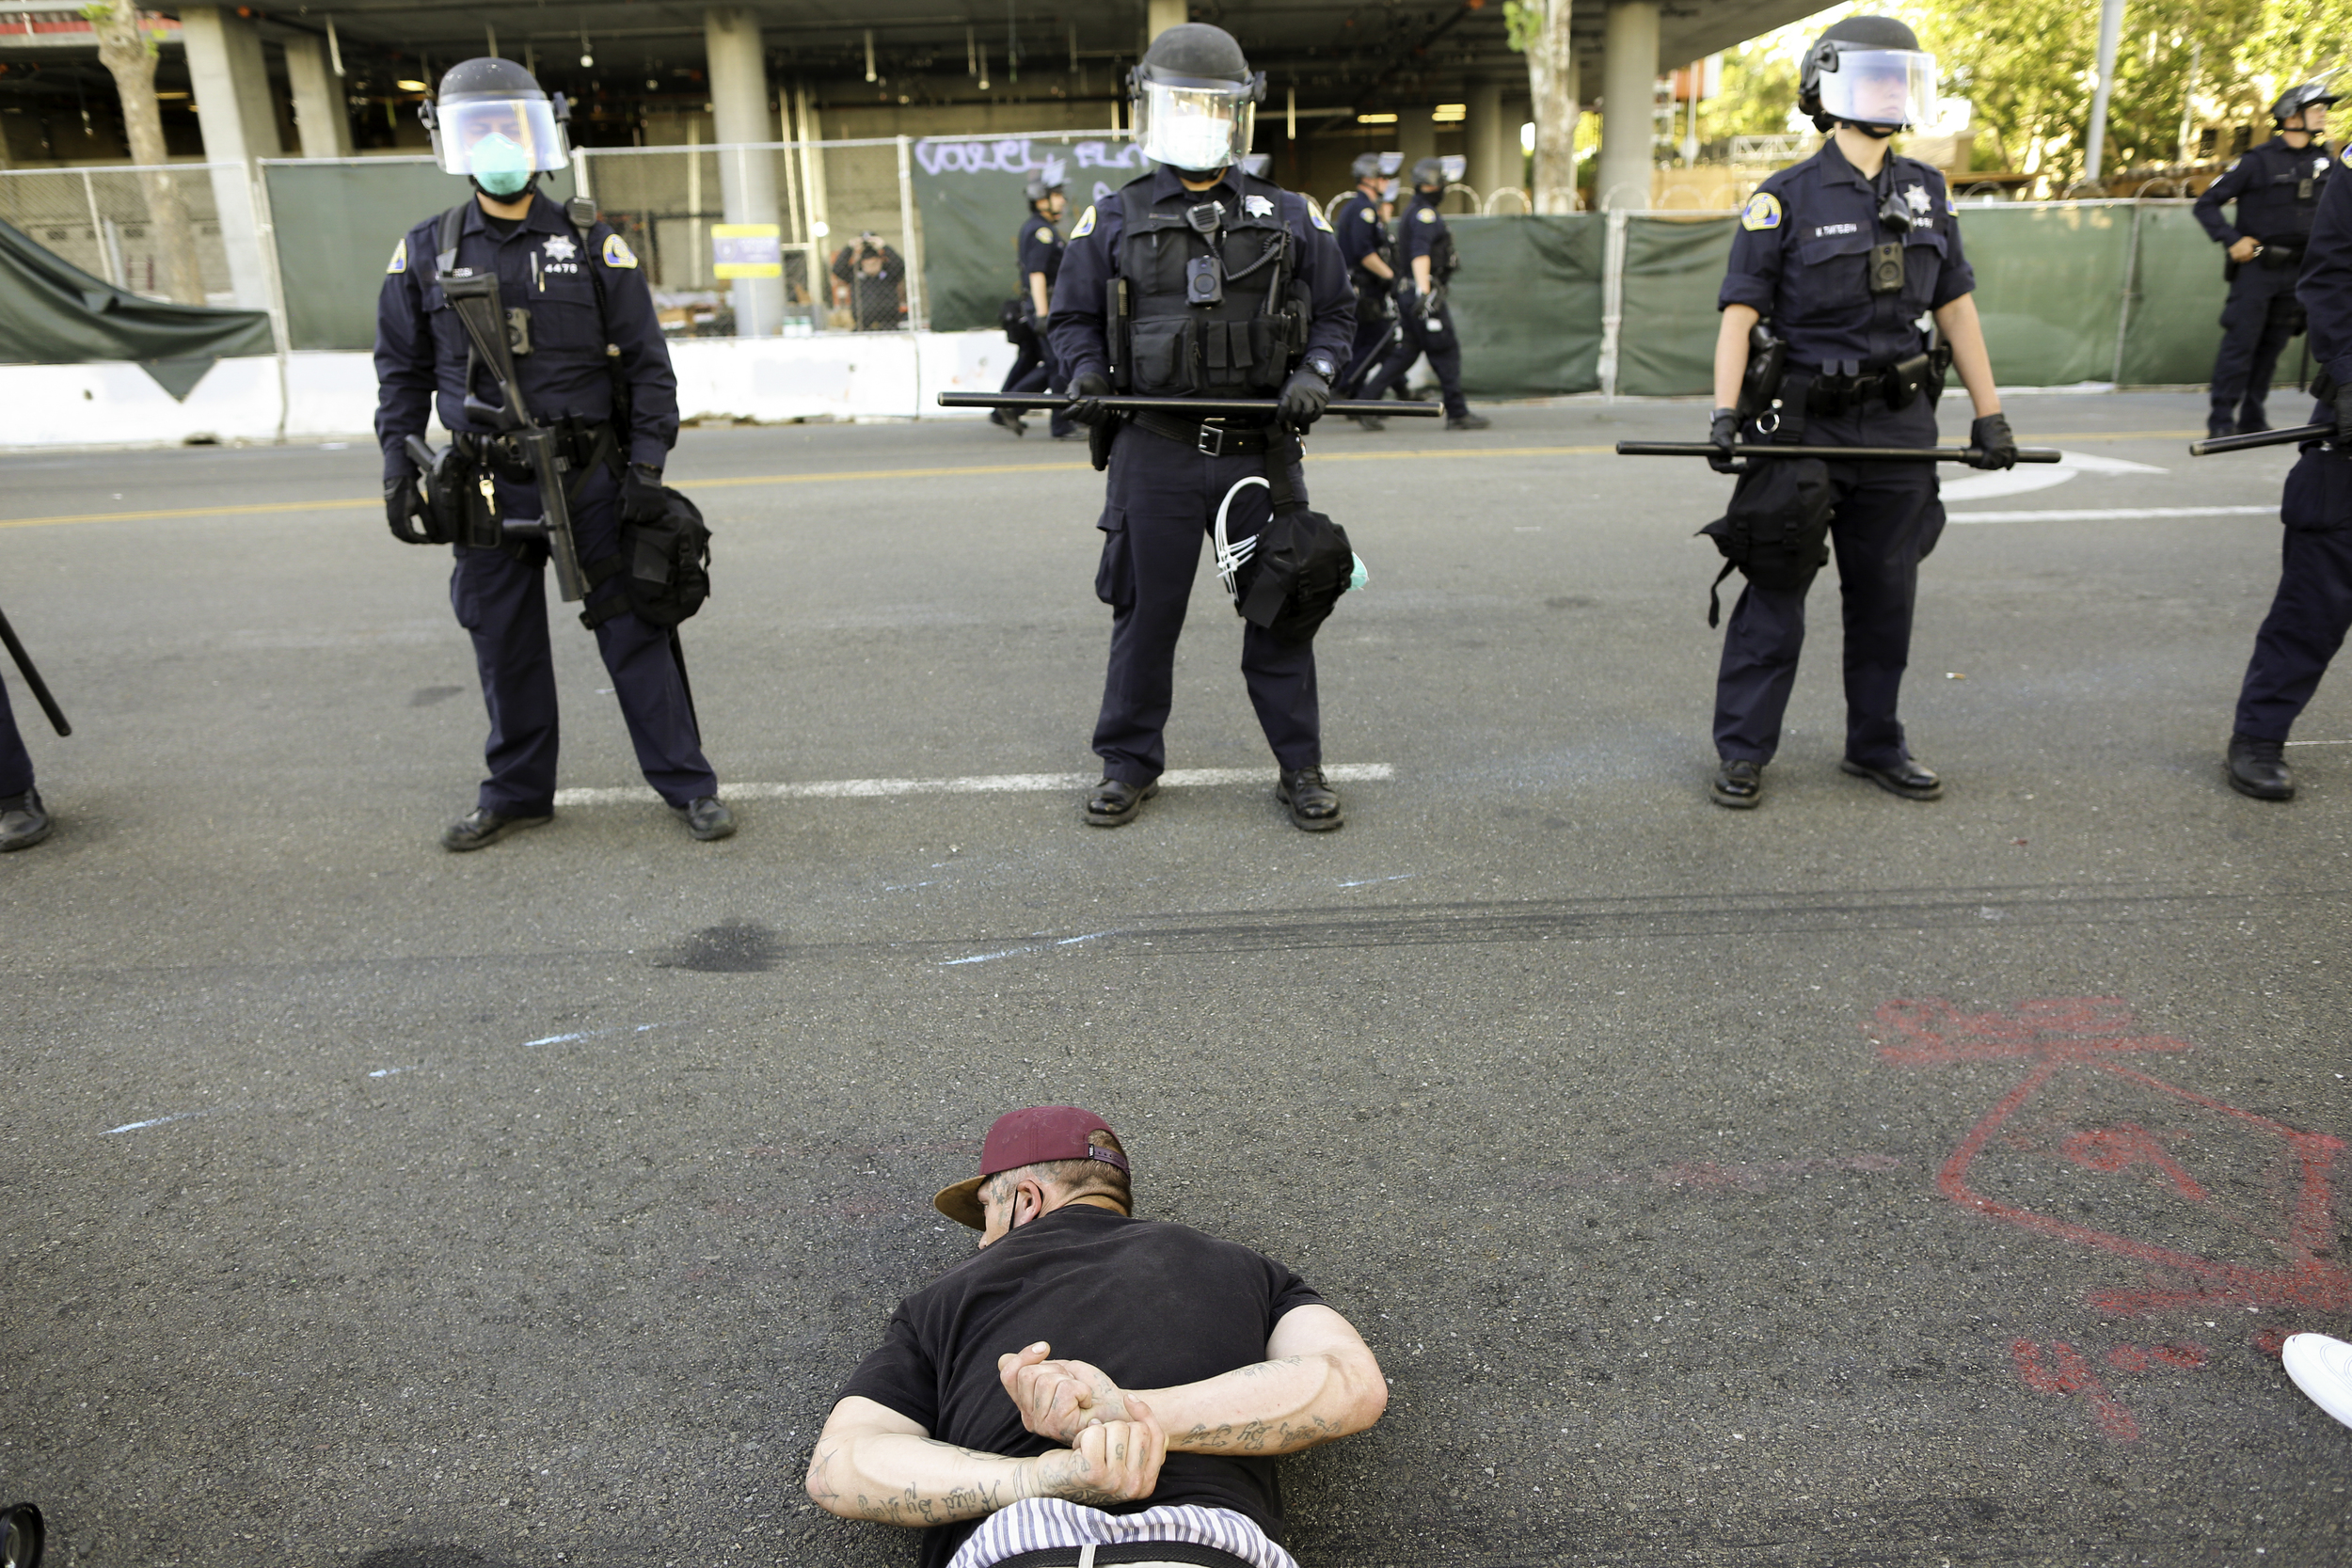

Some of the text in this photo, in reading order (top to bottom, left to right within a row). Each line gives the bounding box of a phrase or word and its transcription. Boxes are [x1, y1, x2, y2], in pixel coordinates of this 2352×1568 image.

[1180, 1422, 1232, 1448] Few
[1237, 1418, 1273, 1451] By
[857, 1493, 904, 1523] Many
[904, 1481, 942, 1524] By
